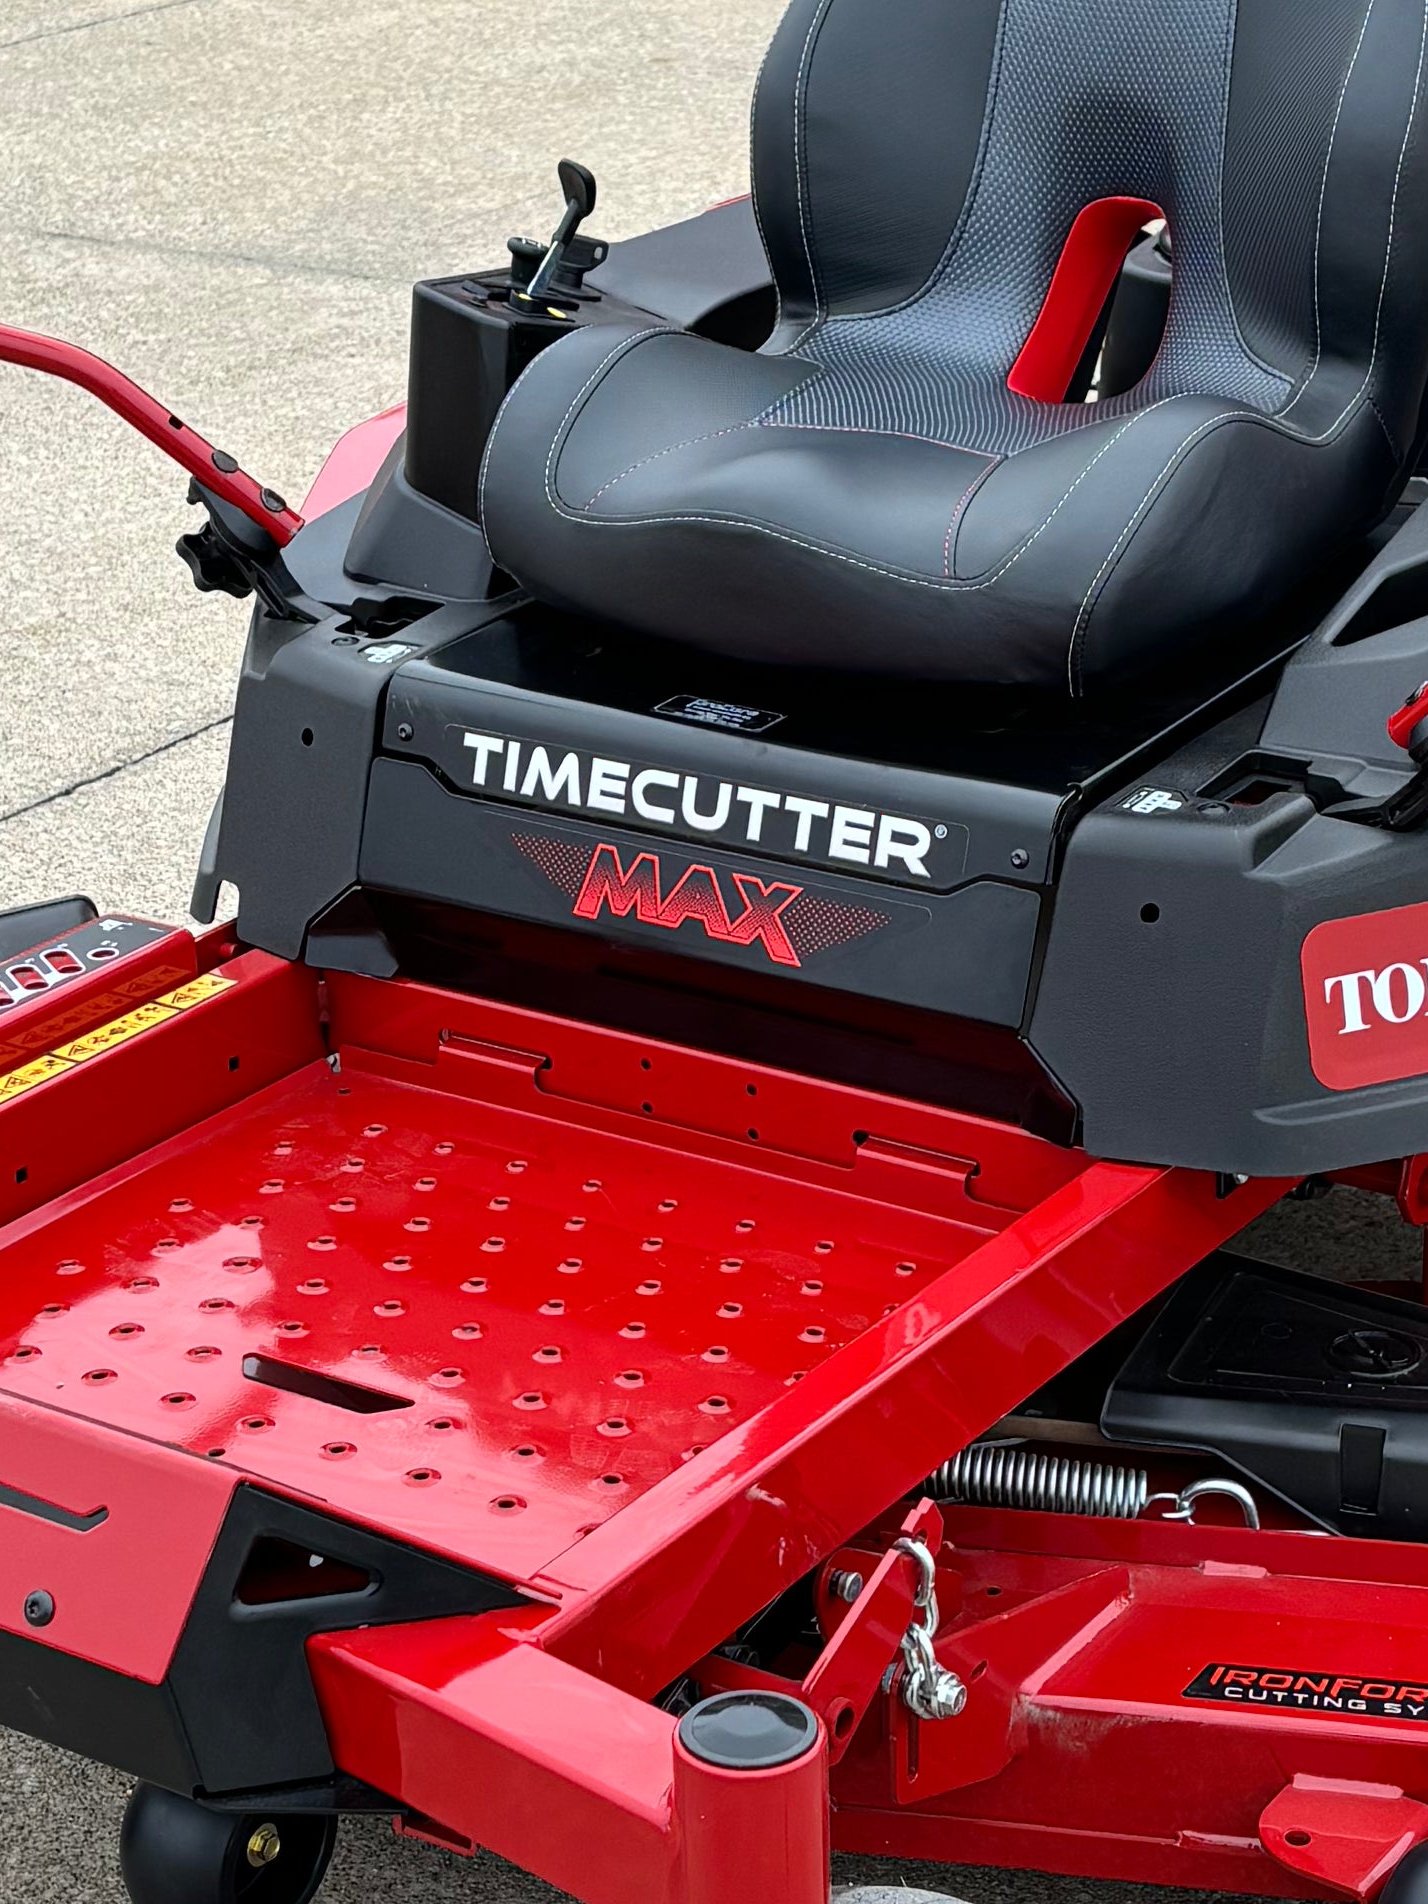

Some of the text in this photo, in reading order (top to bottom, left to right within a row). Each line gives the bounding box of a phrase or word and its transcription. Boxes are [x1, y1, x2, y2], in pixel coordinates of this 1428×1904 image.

[463, 731, 932, 879] TIMECUTTER
[573, 842, 804, 968] MAX
[1224, 1686, 1367, 1712] CUTTING
